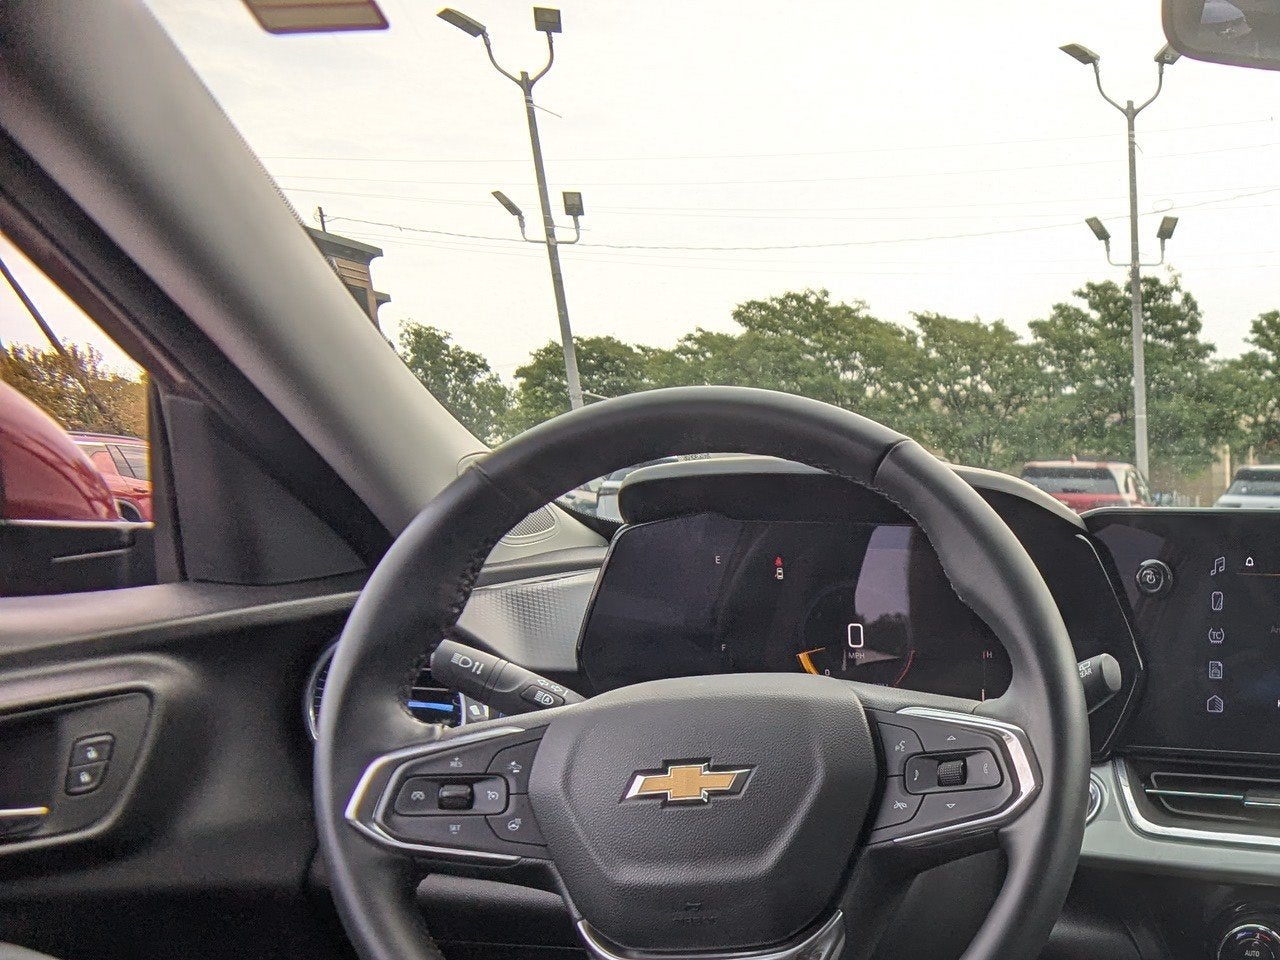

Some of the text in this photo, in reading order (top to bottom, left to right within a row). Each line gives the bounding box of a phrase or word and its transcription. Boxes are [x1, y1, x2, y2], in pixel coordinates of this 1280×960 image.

[715, 555, 721, 564] E
[847, 622, 864, 648] 0
[848, 651, 866, 660] MPH
[1244, 949, 1260, 958] AUTO
